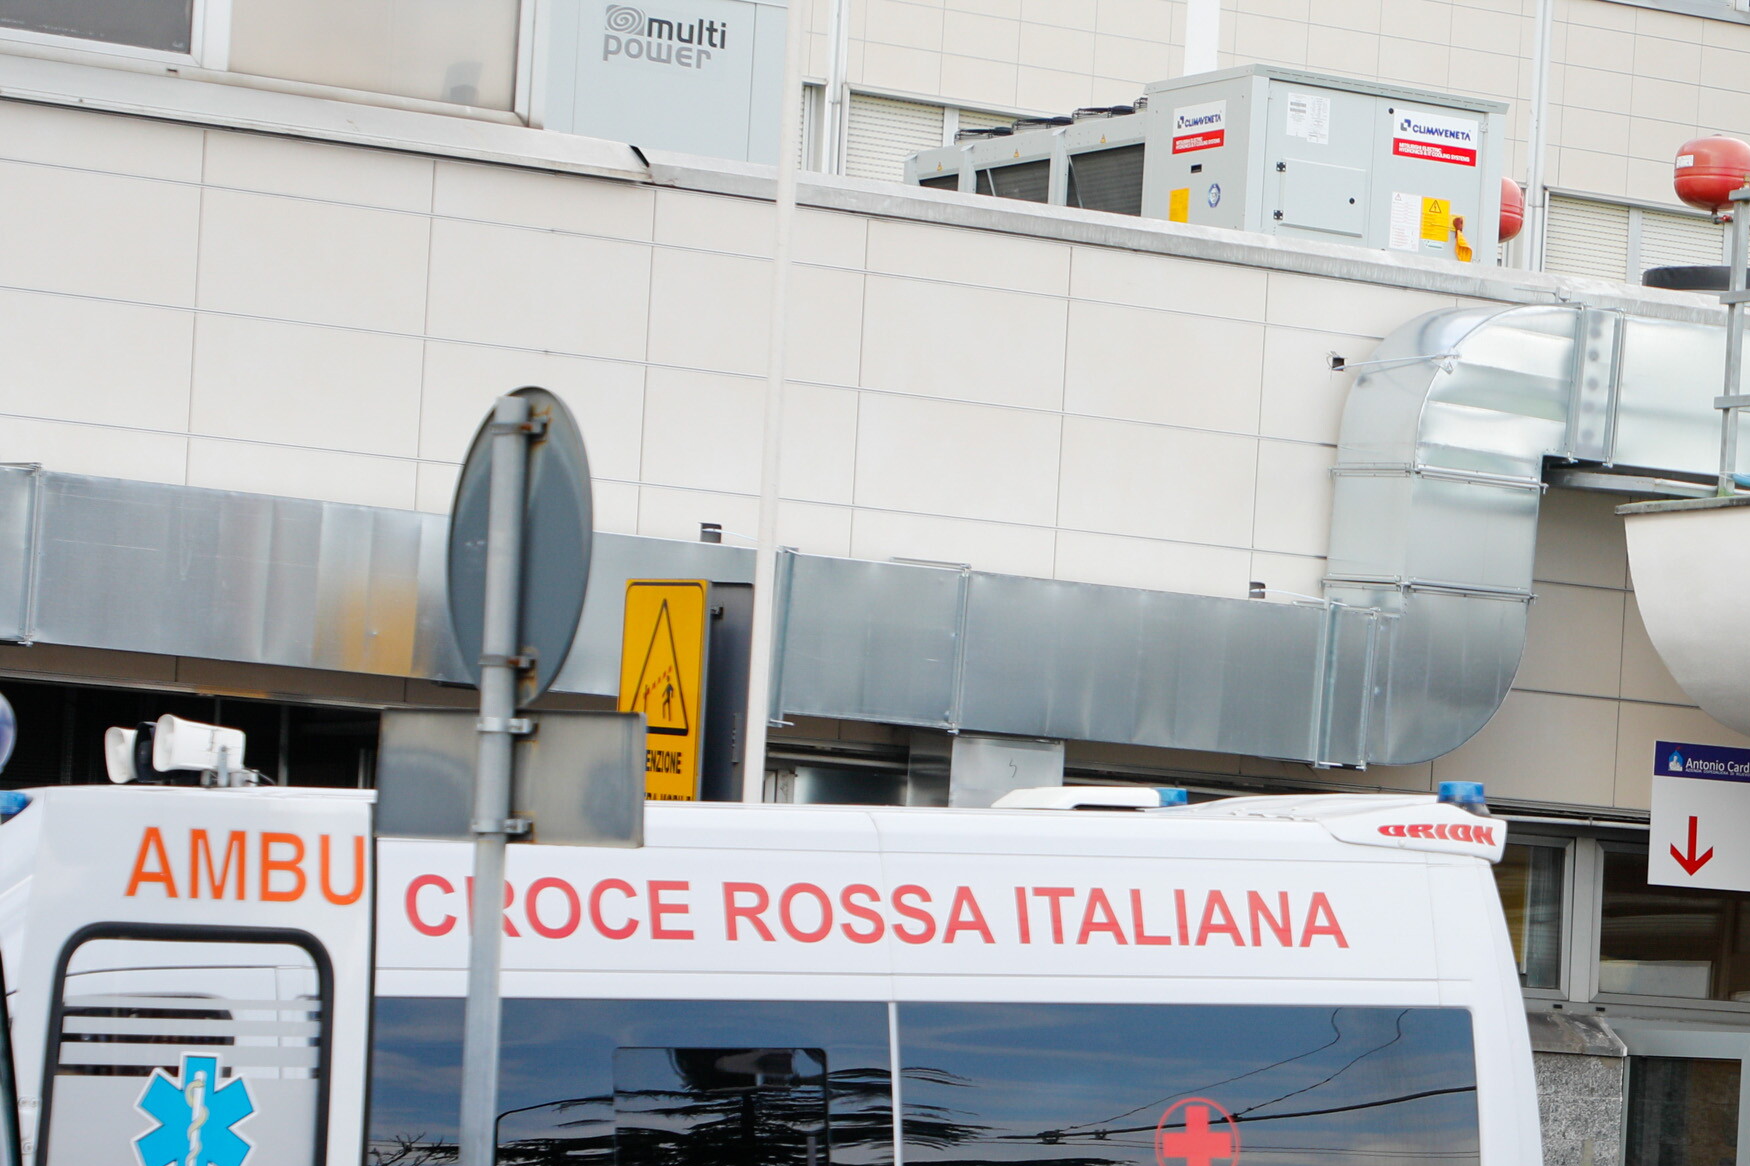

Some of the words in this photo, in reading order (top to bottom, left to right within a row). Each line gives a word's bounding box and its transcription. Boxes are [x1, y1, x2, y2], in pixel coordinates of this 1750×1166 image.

[647, 17, 727, 49] multi
[602, 33, 712, 69] power
[1412, 124, 1471, 141] CLIMAVENETA
[645, 749, 682, 774] ENZIONE
[1685, 757, 1725, 772] Antonio
[1377, 823, 1496, 846] ORION
[124, 826, 365, 905] AMBU
[722, 881, 996, 945] ROSSA
[1014, 886, 1350, 949] ITALIANA
